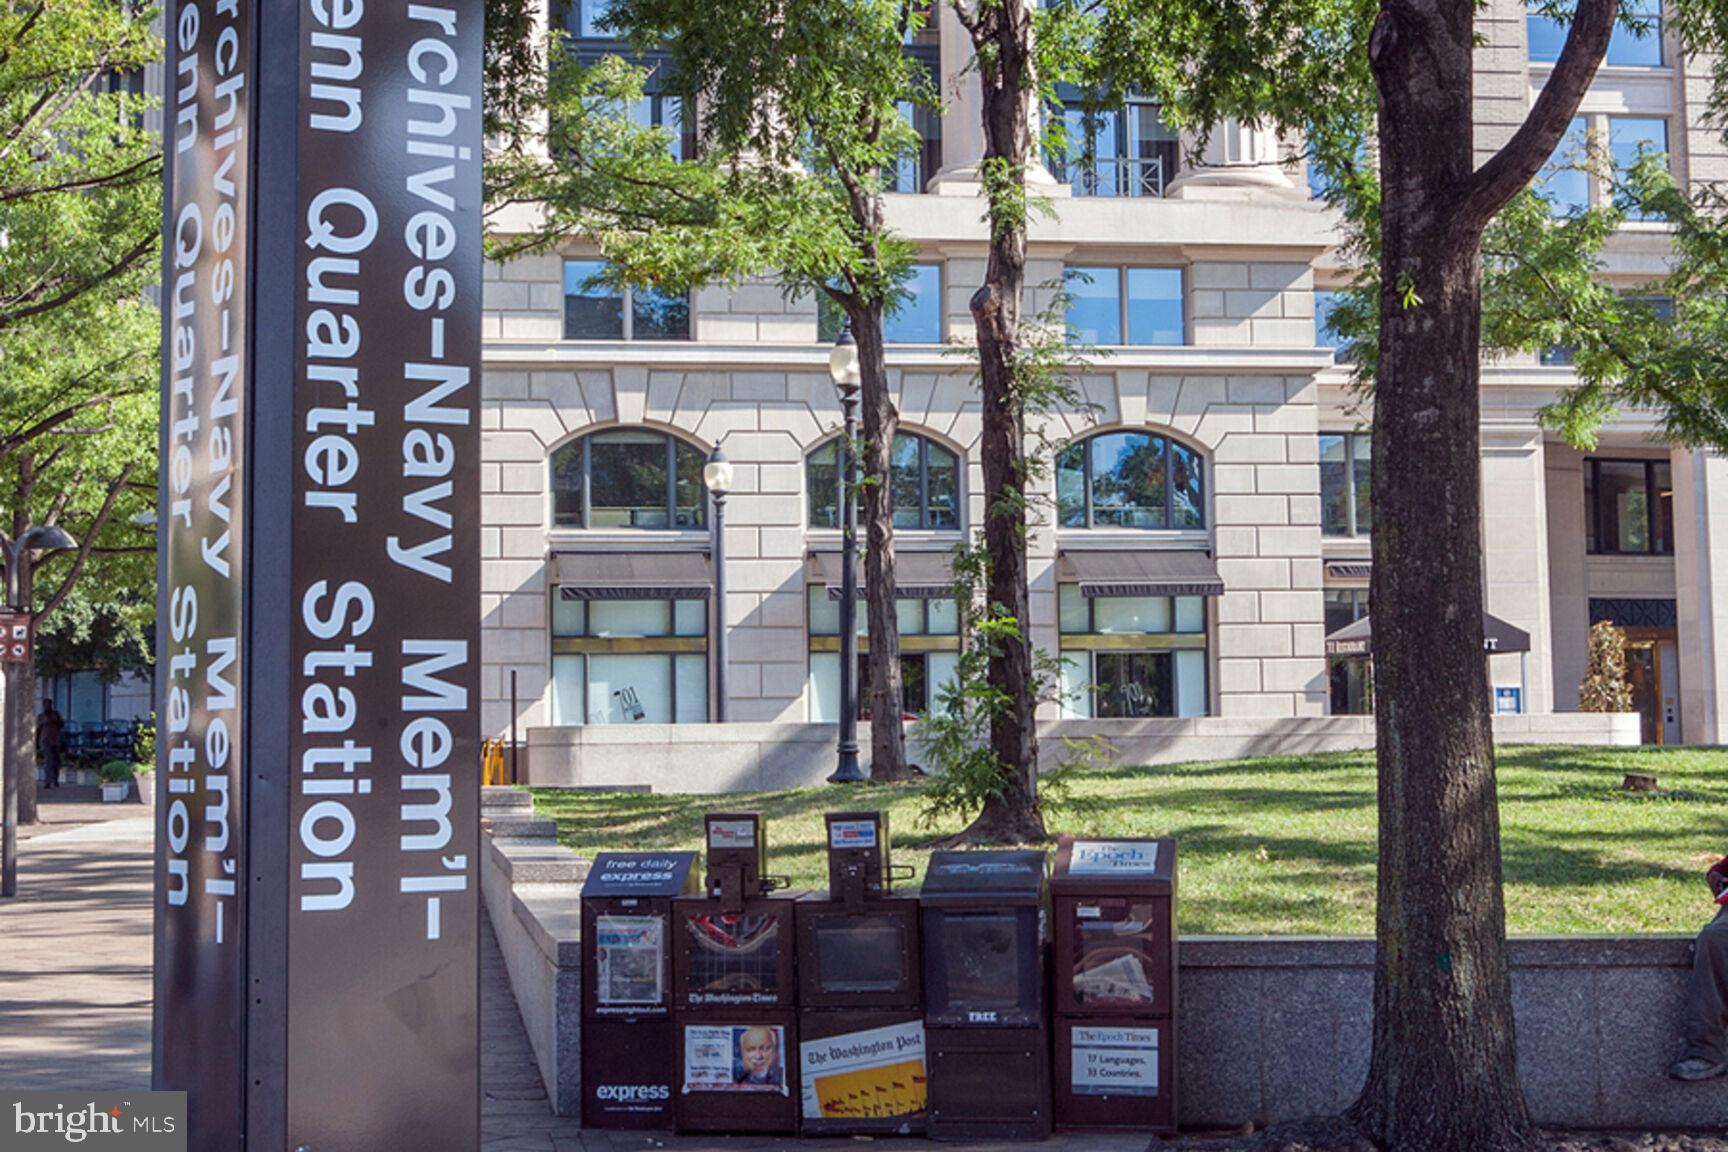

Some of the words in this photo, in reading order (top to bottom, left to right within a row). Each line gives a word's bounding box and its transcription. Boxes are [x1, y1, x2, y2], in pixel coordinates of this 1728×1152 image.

[176, 2, 200, 154] enn
[310, 0, 364, 133] enn
[171, 202, 203, 528] Quarter
[304, 187, 379, 523] Quarter
[167, 584, 198, 906] Station
[300, 580, 375, 912] Station
[600, 871, 673, 883] express
[606, 860, 637, 869] free
[640, 859, 678, 871] daily
[596, 1084, 671, 1102] express
[807, 1051, 828, 1065] The
[828, 1039, 895, 1061] Washington
[895, 1033, 922, 1052] Post
